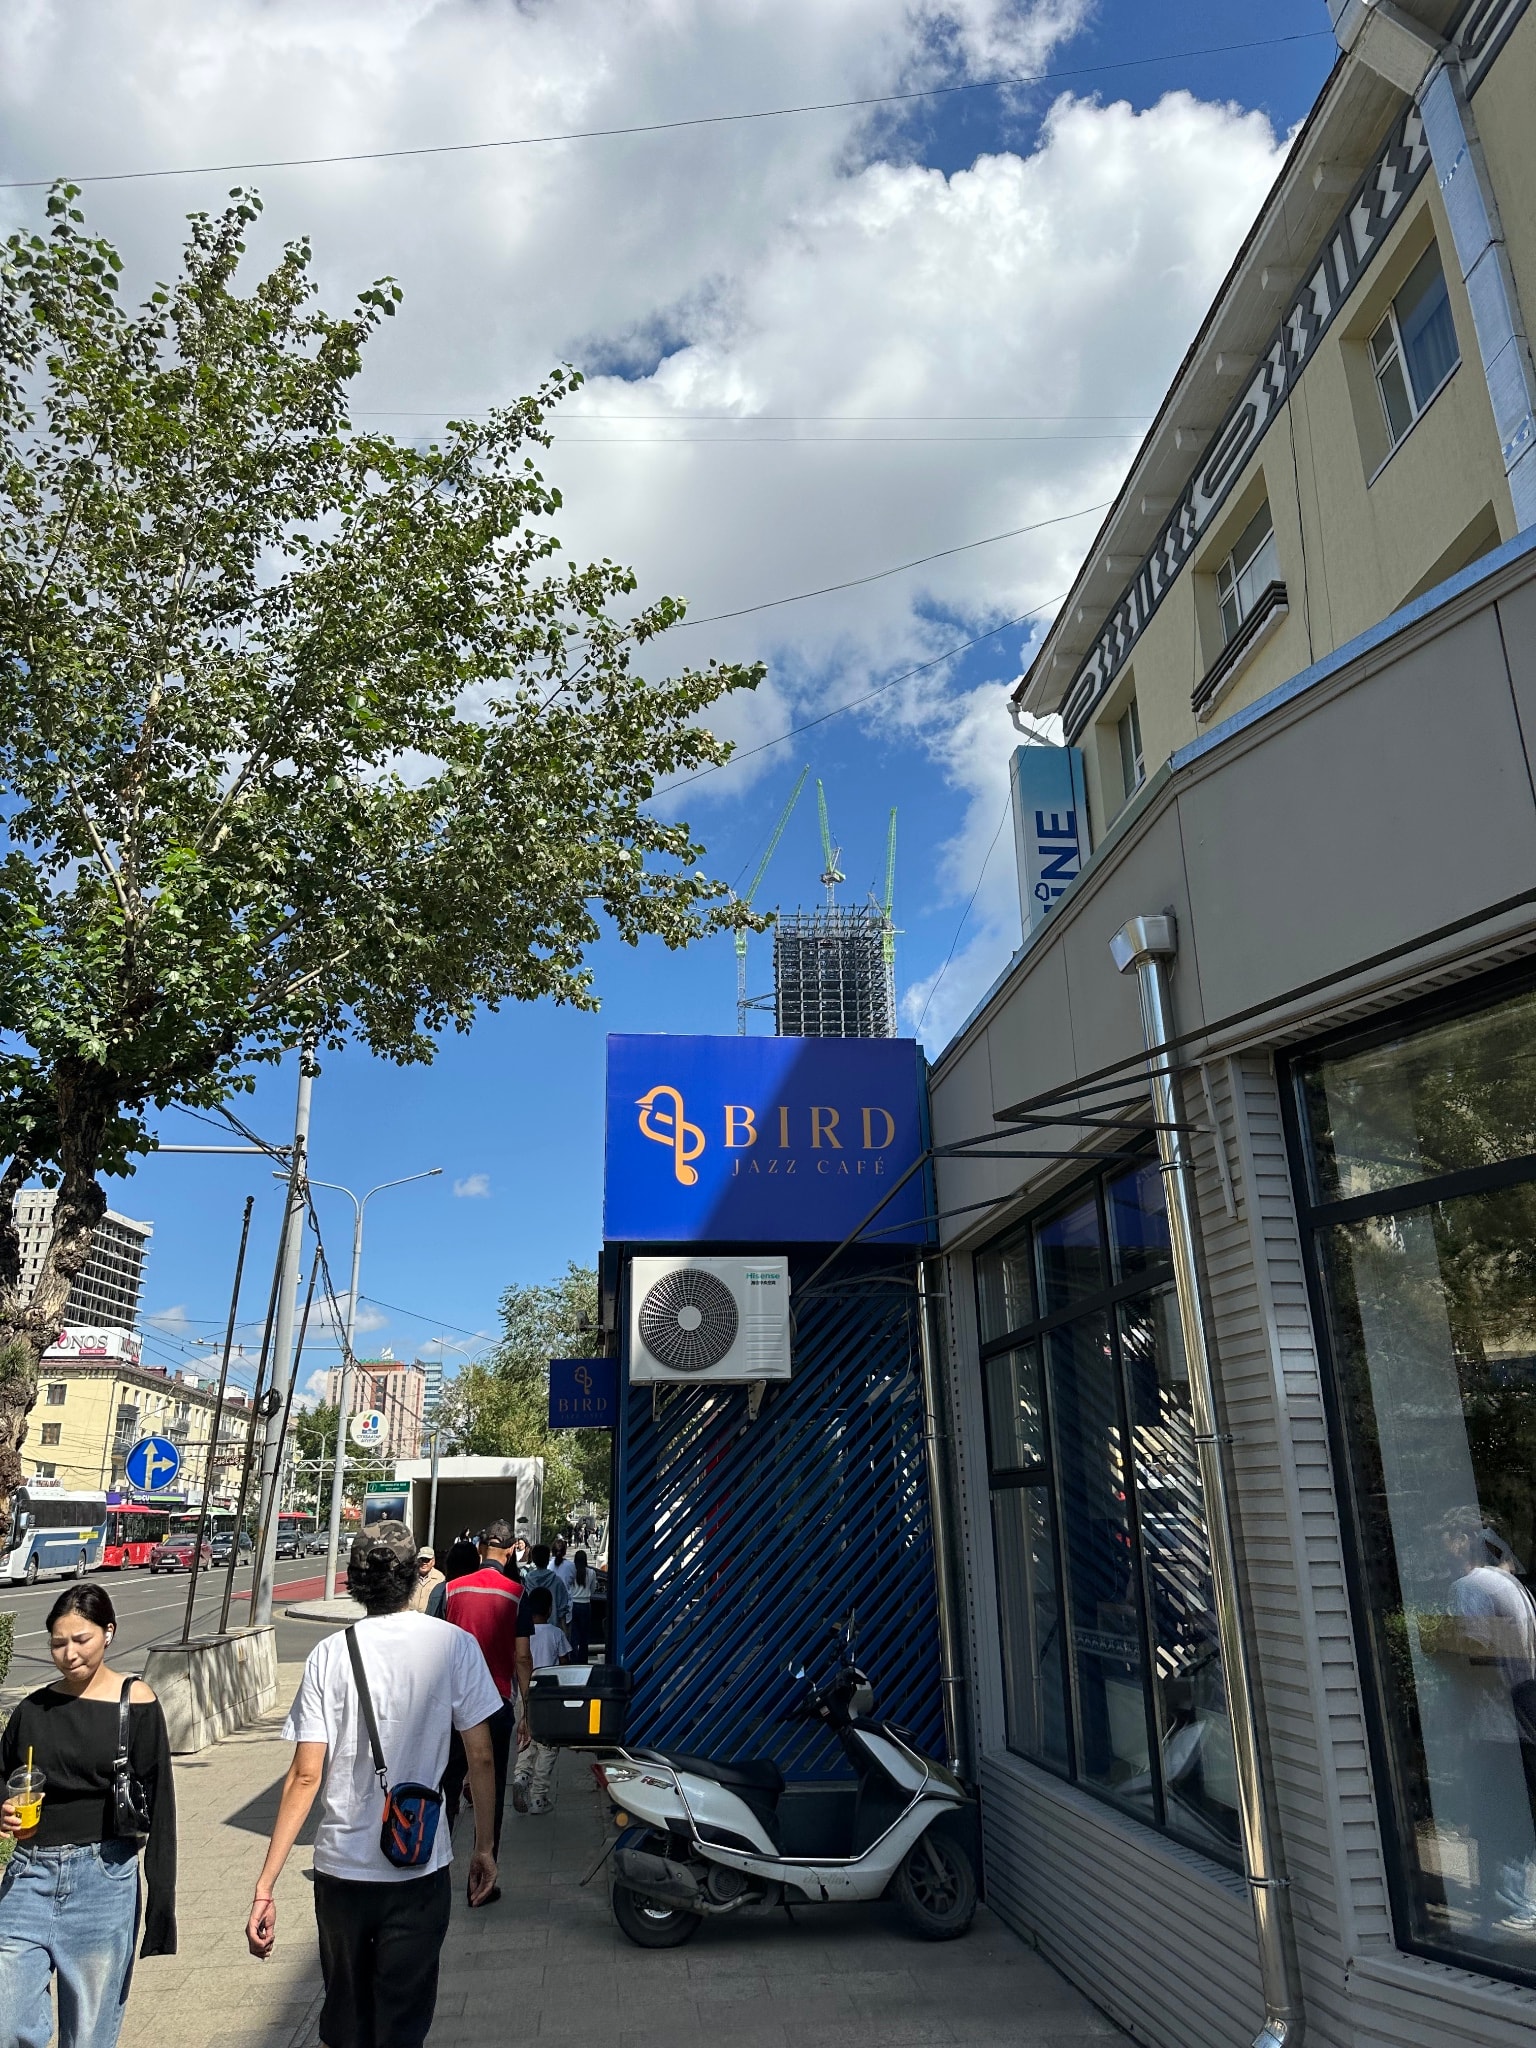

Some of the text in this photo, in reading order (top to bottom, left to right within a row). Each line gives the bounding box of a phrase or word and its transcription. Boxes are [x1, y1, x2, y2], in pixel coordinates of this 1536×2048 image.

[723, 1105, 896, 1149] BIRD
[732, 1156, 885, 1177] JAZZ CAFÉ
[746, 1272, 781, 1280] Hisense
[51, 1331, 109, 1350] ONOS
[559, 1398, 608, 1412] BIRD
